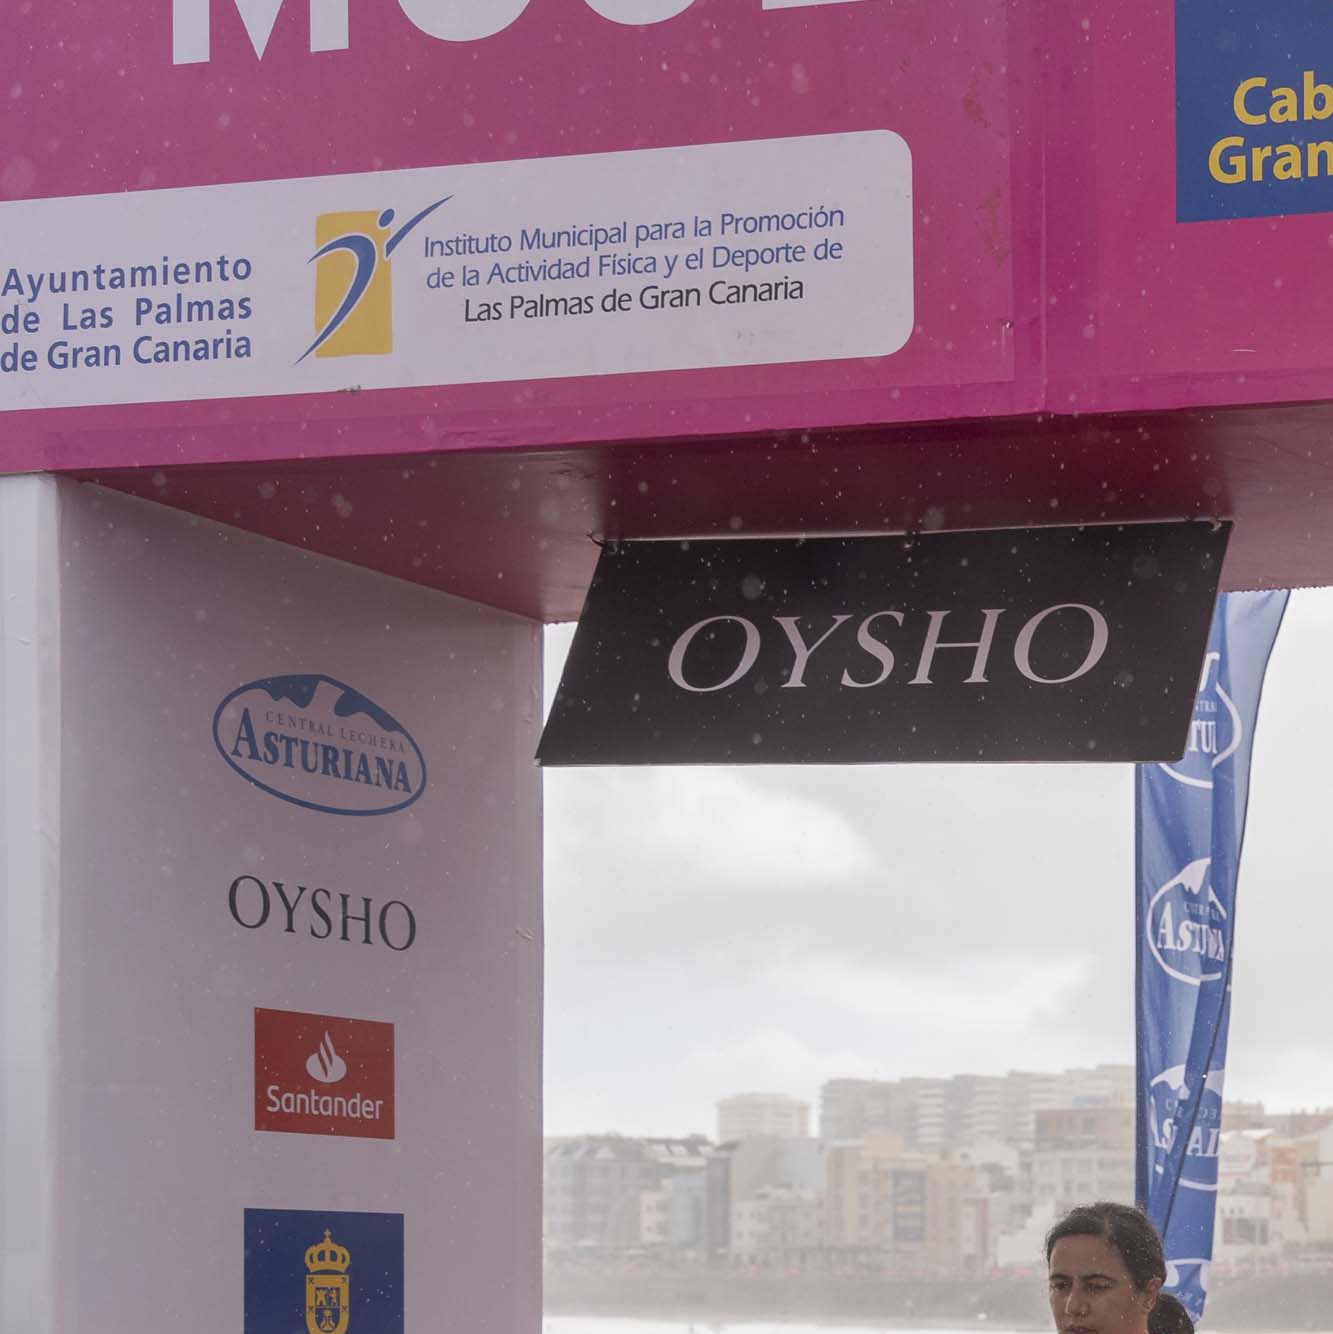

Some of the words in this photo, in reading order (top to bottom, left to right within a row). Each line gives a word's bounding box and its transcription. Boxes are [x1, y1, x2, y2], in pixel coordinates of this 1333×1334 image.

[424, 231, 512, 257] Instituto
[519, 221, 627, 253] Municipal
[635, 220, 685, 247] para
[694, 216, 711, 238] la
[720, 205, 844, 236] Promoción
[1, 255, 252, 301] Ayuntamiento
[426, 266, 454, 290] de
[462, 263, 479, 286] la
[487, 254, 590, 285] Actividad
[598, 252, 657, 277] Física
[664, 254, 678, 279] y
[685, 247, 703, 271] el
[712, 242, 805, 272] Deporte
[814, 238, 843, 261] de
[1, 304, 40, 334] de
[63, 302, 113, 330] Las
[136, 294, 252, 326] Palmas
[464, 297, 502, 322] Las
[509, 292, 594, 319] Palmas
[601, 288, 631, 312] de
[639, 284, 701, 309] Gran
[708, 276, 803, 304] Canaria
[1, 342, 37, 373] de
[48, 341, 121, 369] Gran
[133, 329, 251, 364] Canaria
[667, 604, 1108, 691] OYSHO
[231, 707, 412, 793] ASTURIANA
[265, 711, 335, 737] CENTRAL
[340, 730, 406, 753] LECHERA
[228, 875, 416, 951] OYSHO
[266, 1085, 384, 1121] Santander
